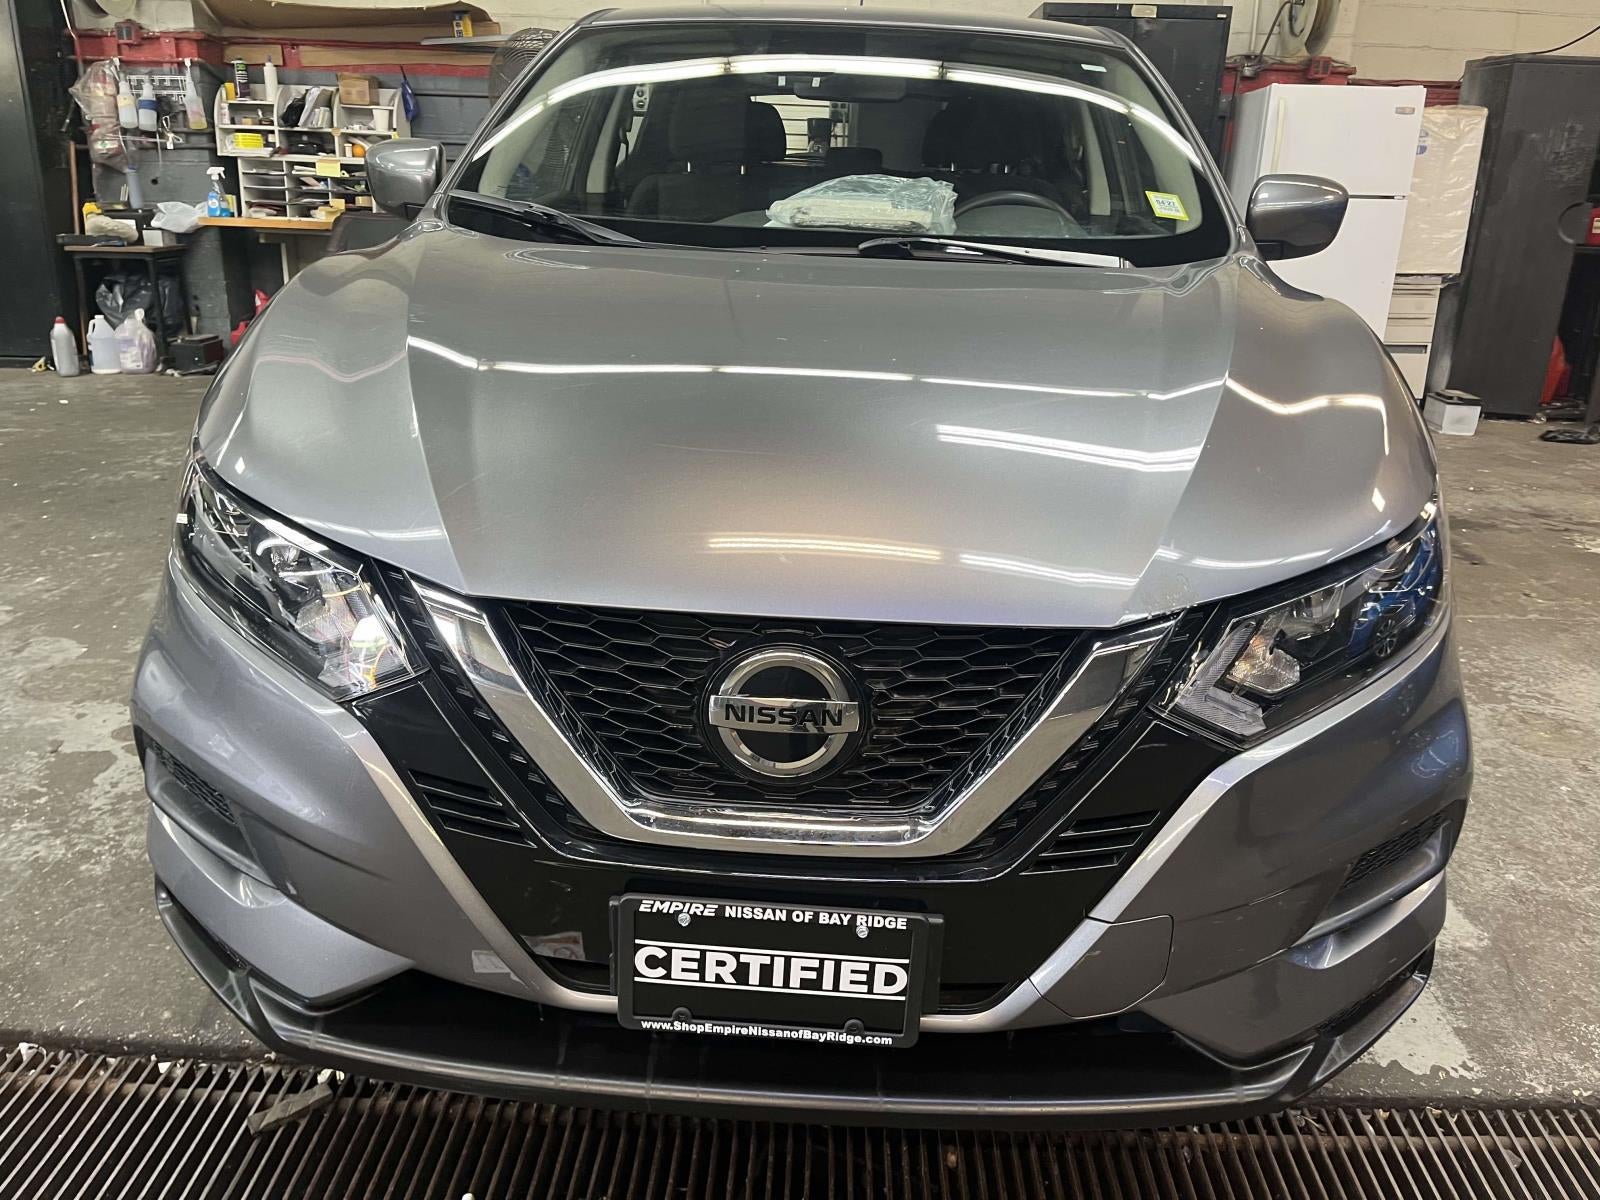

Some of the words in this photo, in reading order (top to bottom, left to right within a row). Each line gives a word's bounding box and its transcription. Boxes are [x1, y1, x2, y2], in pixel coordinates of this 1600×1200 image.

[725, 703, 843, 727] NISSAN
[638, 899, 719, 917] EMPIRE
[724, 905, 787, 922] NISSAN
[791, 910, 814, 923] OF
[818, 912, 852, 926] BAY
[856, 914, 908, 930] RIDGE
[634, 946, 908, 994] CERTIFIED
[640, 1020, 893, 1045] www.ShopEmpireNissanofBayRidge.com
